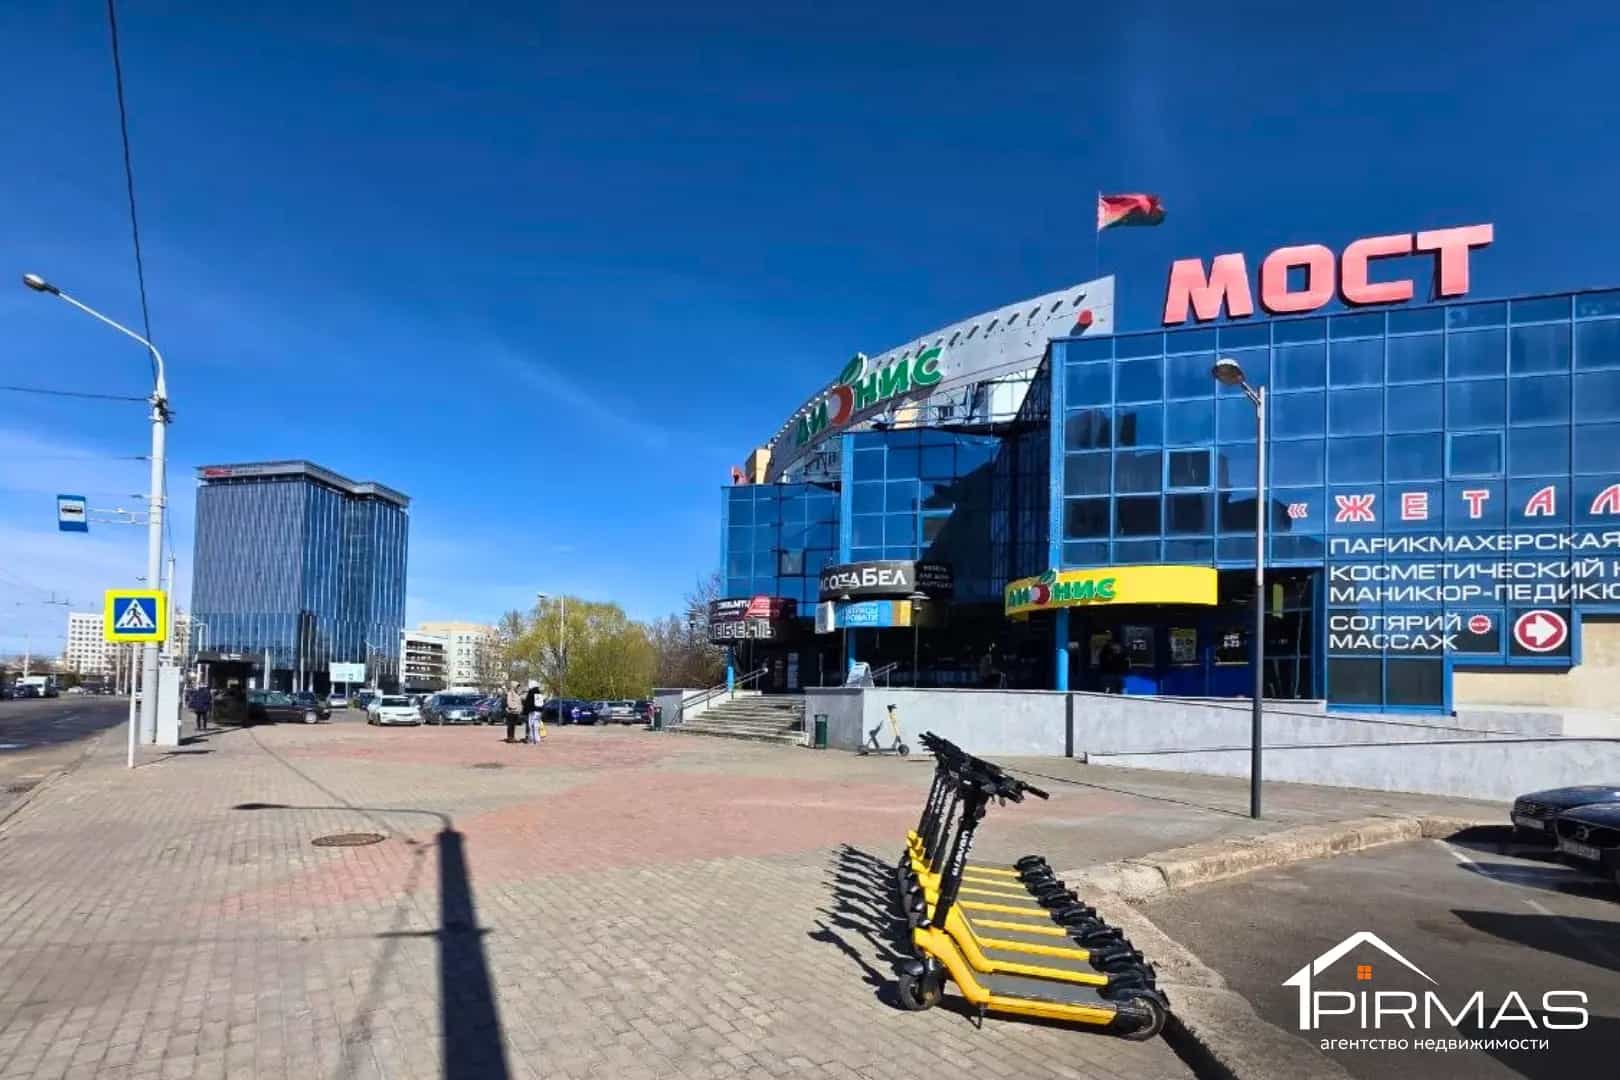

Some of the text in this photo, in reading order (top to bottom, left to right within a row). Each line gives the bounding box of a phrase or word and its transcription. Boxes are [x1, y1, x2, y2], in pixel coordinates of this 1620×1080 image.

[1163, 223, 1494, 326] МОСТ
[1330, 532, 1620, 555] ПАРИКМАХЕРСКАЯ
[1330, 557, 1605, 581] КОСМЕТИЧЕСКИЙ
[1330, 613, 1461, 632] СОЛЯРИЙ
[1330, 634, 1458, 650] МАССАЖ
